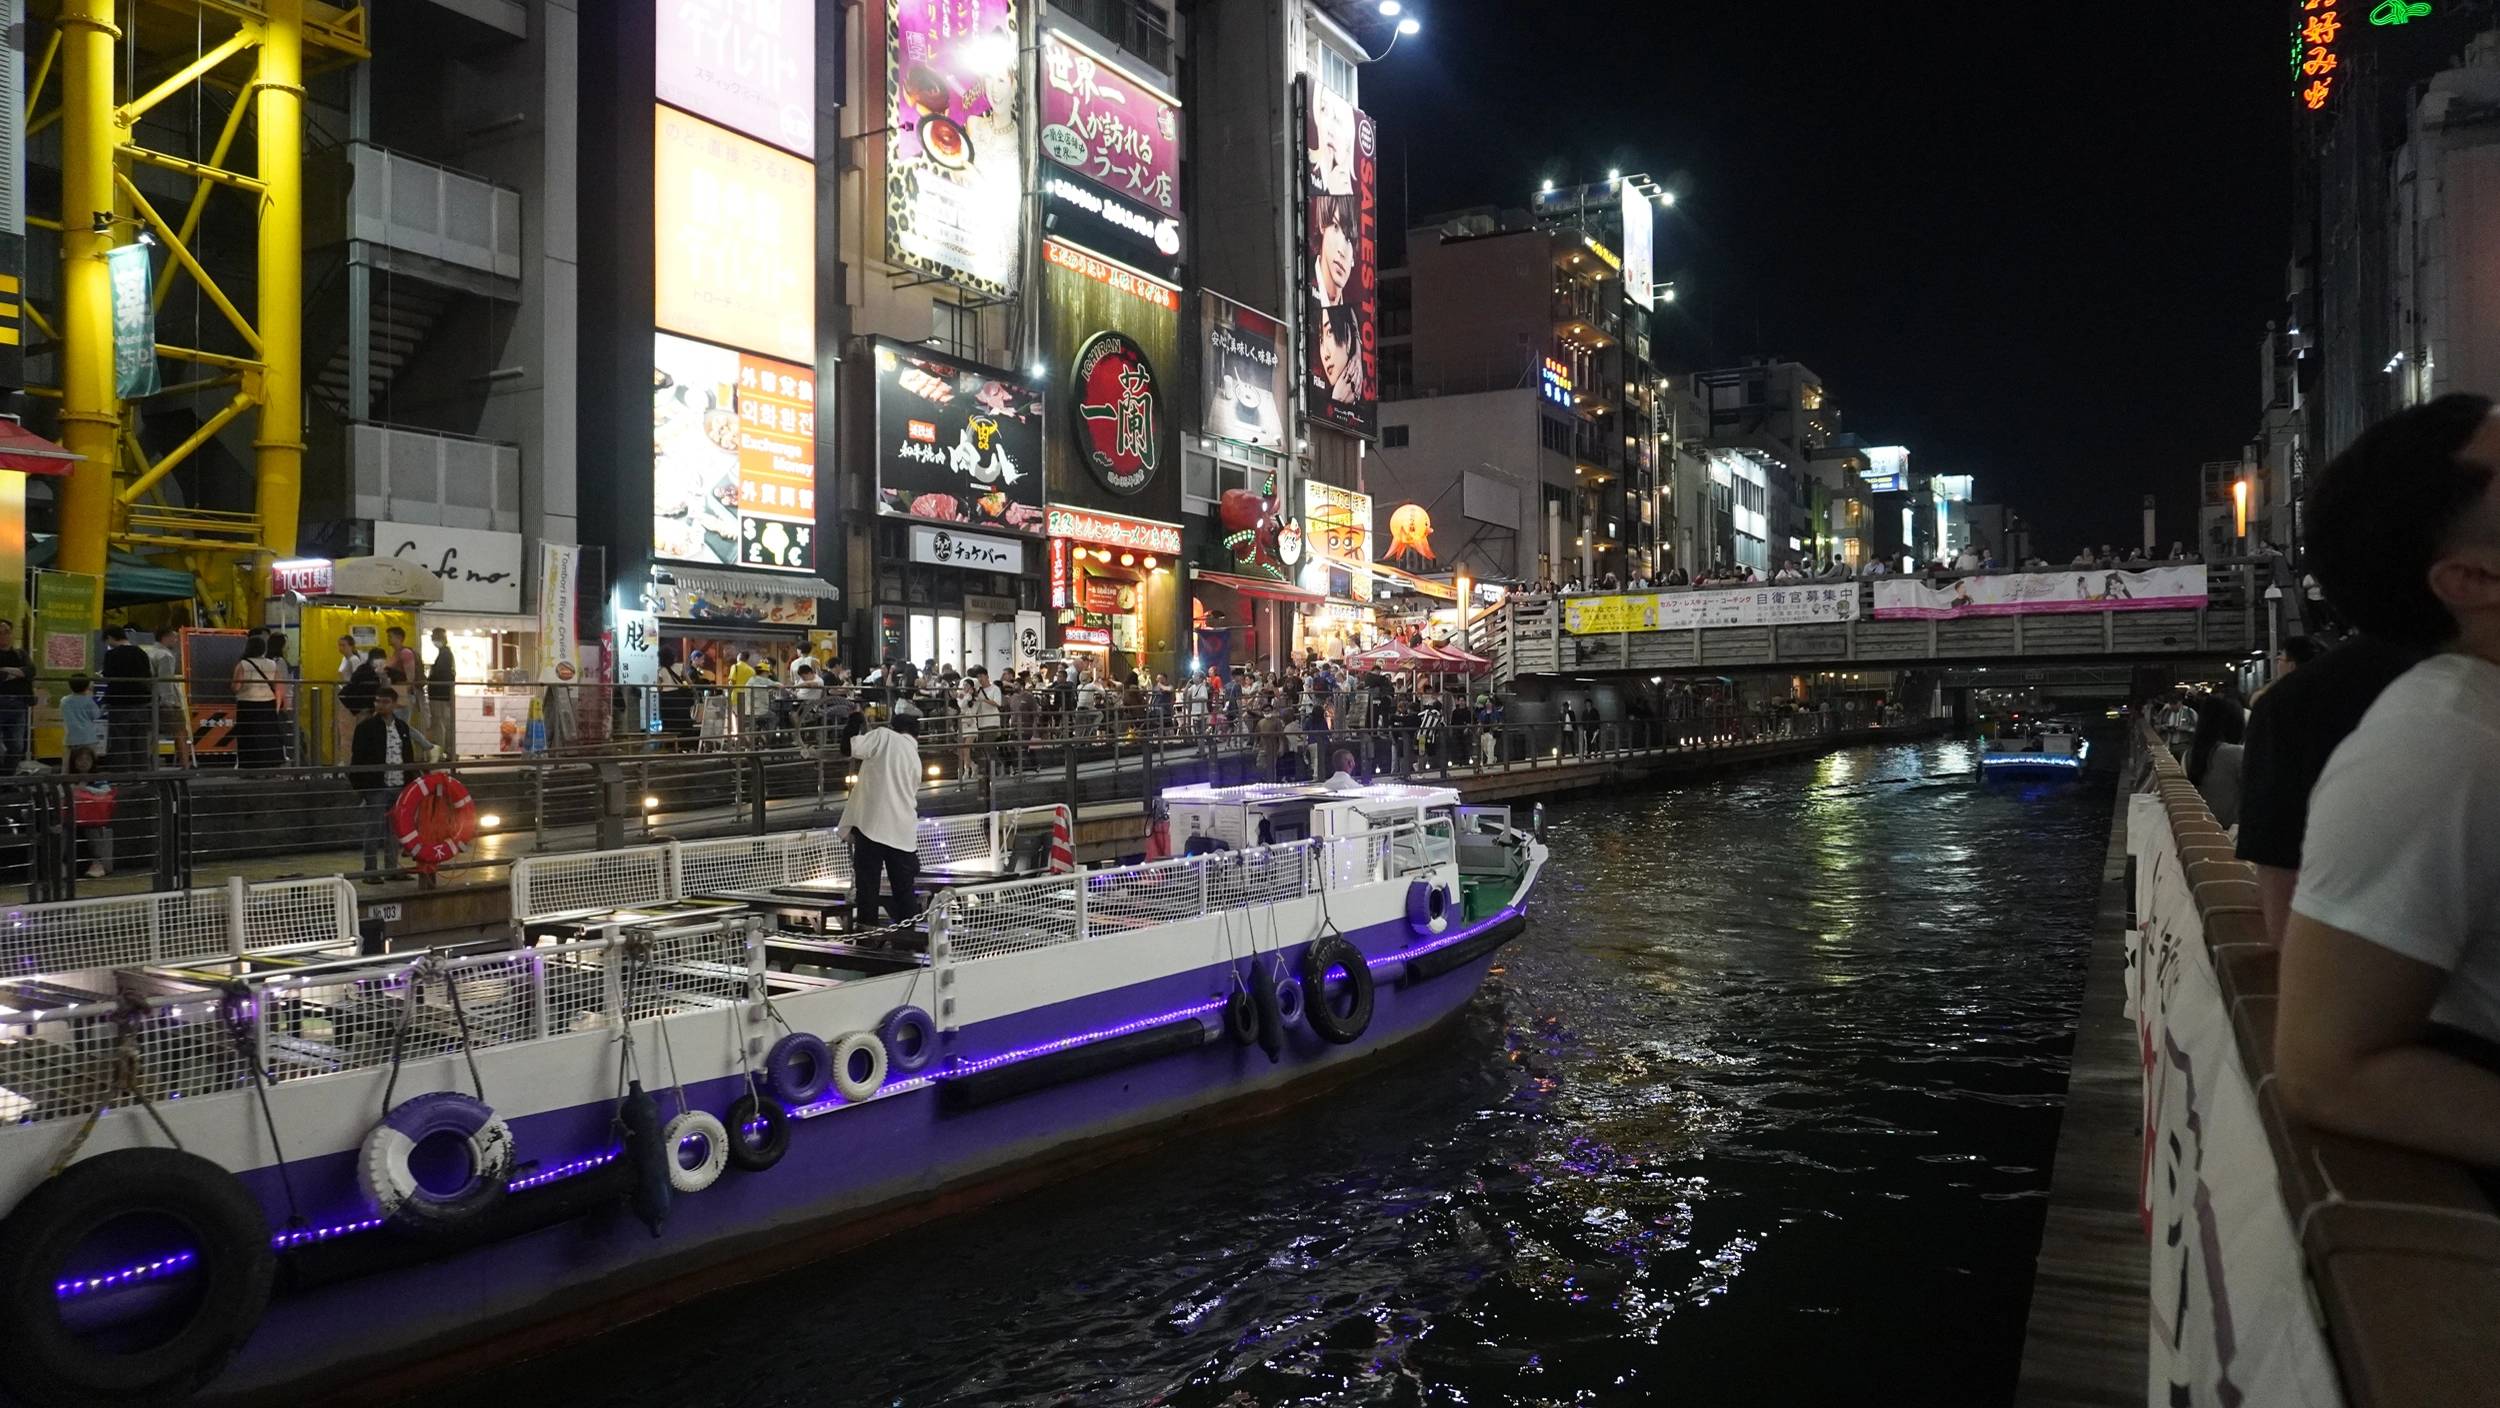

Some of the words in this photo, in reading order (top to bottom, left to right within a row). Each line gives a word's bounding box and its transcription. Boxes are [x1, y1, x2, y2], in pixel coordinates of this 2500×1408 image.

[1045, 45, 1126, 104] 世界一
[1067, 96, 1153, 165] 人が訪れる
[1094, 146, 1173, 208] ラーメン店
[1360, 157, 1375, 290] SALES
[1081, 338, 1121, 383] ICHIRAN
[1361, 301, 1376, 401] TOP3
[1080, 363, 1155, 470] 一蘭
[955, 541, 1007, 564] チョケバー
[281, 568, 314, 591] TICKET
[1757, 588, 1853, 605] 自衛官募集中
[558, 596, 567, 623] River
[558, 626, 567, 660] Cruise
